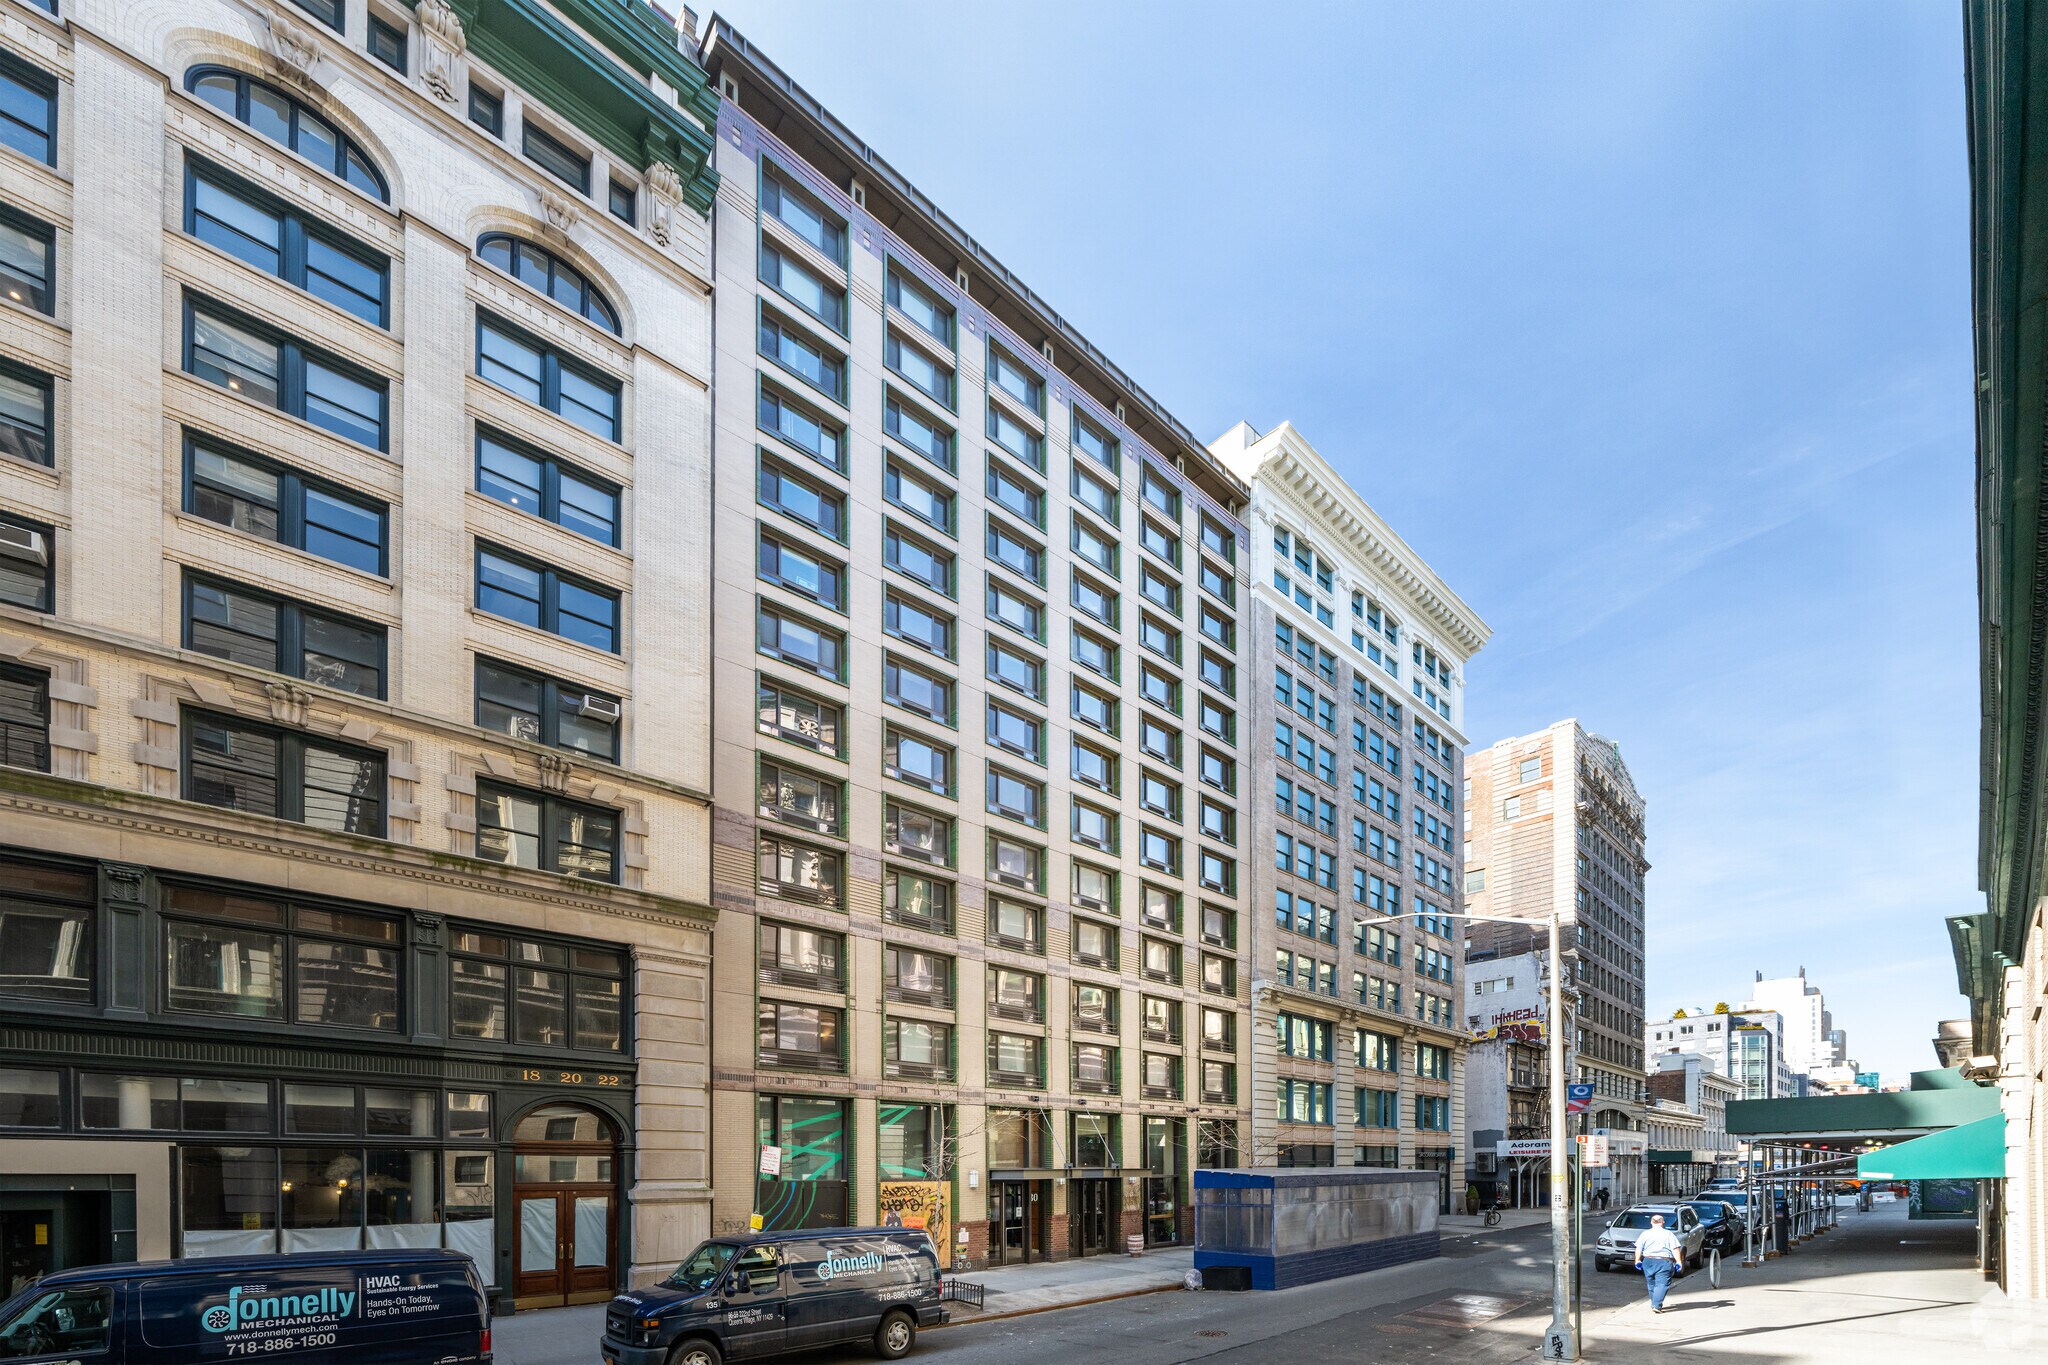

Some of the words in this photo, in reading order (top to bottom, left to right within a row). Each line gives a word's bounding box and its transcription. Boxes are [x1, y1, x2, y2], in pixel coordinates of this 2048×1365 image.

[522, 1069, 540, 1082] 18
[560, 1072, 582, 1084] 20
[598, 1074, 619, 1086] 22
[817, 1250, 882, 1280] donnelly
[366, 1275, 400, 1288] HVAC
[833, 1270, 877, 1278] MECHANICAL
[366, 1286, 398, 1294] Sustainable
[201, 1286, 356, 1333] donnelly
[366, 1297, 407, 1308] Hands-On
[408, 1295, 433, 1304] Today,
[705, 1301, 718, 1309] 135
[367, 1307, 387, 1319] Eyes
[388, 1307, 400, 1315] On
[401, 1303, 440, 1314] Tomorrow
[240, 1314, 340, 1330] MECHANICAL
[224, 1323, 338, 1341] www.donnellymech.com
[226, 1333, 336, 1356] 718-886-1500
